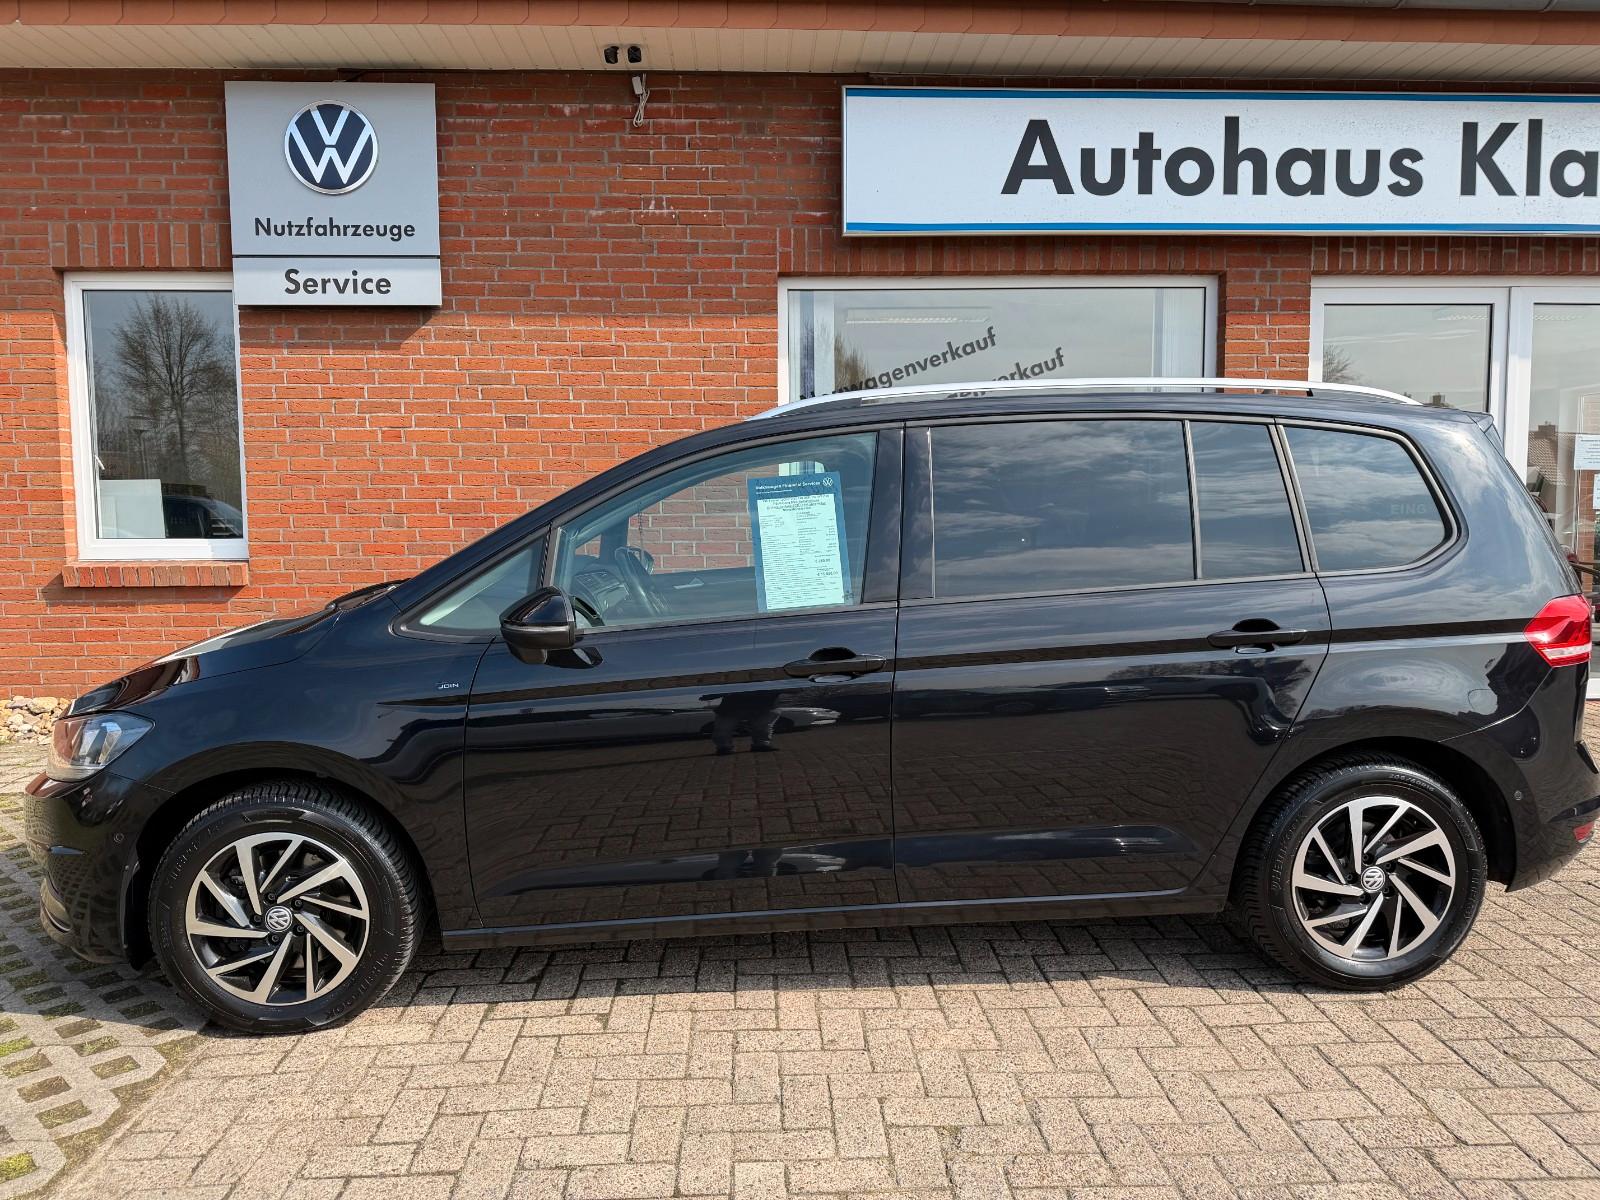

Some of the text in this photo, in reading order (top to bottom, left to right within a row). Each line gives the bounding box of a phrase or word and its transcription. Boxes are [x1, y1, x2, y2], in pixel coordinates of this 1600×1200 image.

[1001, 115, 1599, 198] Autohaus Kla
[254, 216, 416, 242] Nutzfahrzeuge
[284, 268, 392, 295] Service
[436, 682, 459, 690] JOIN
